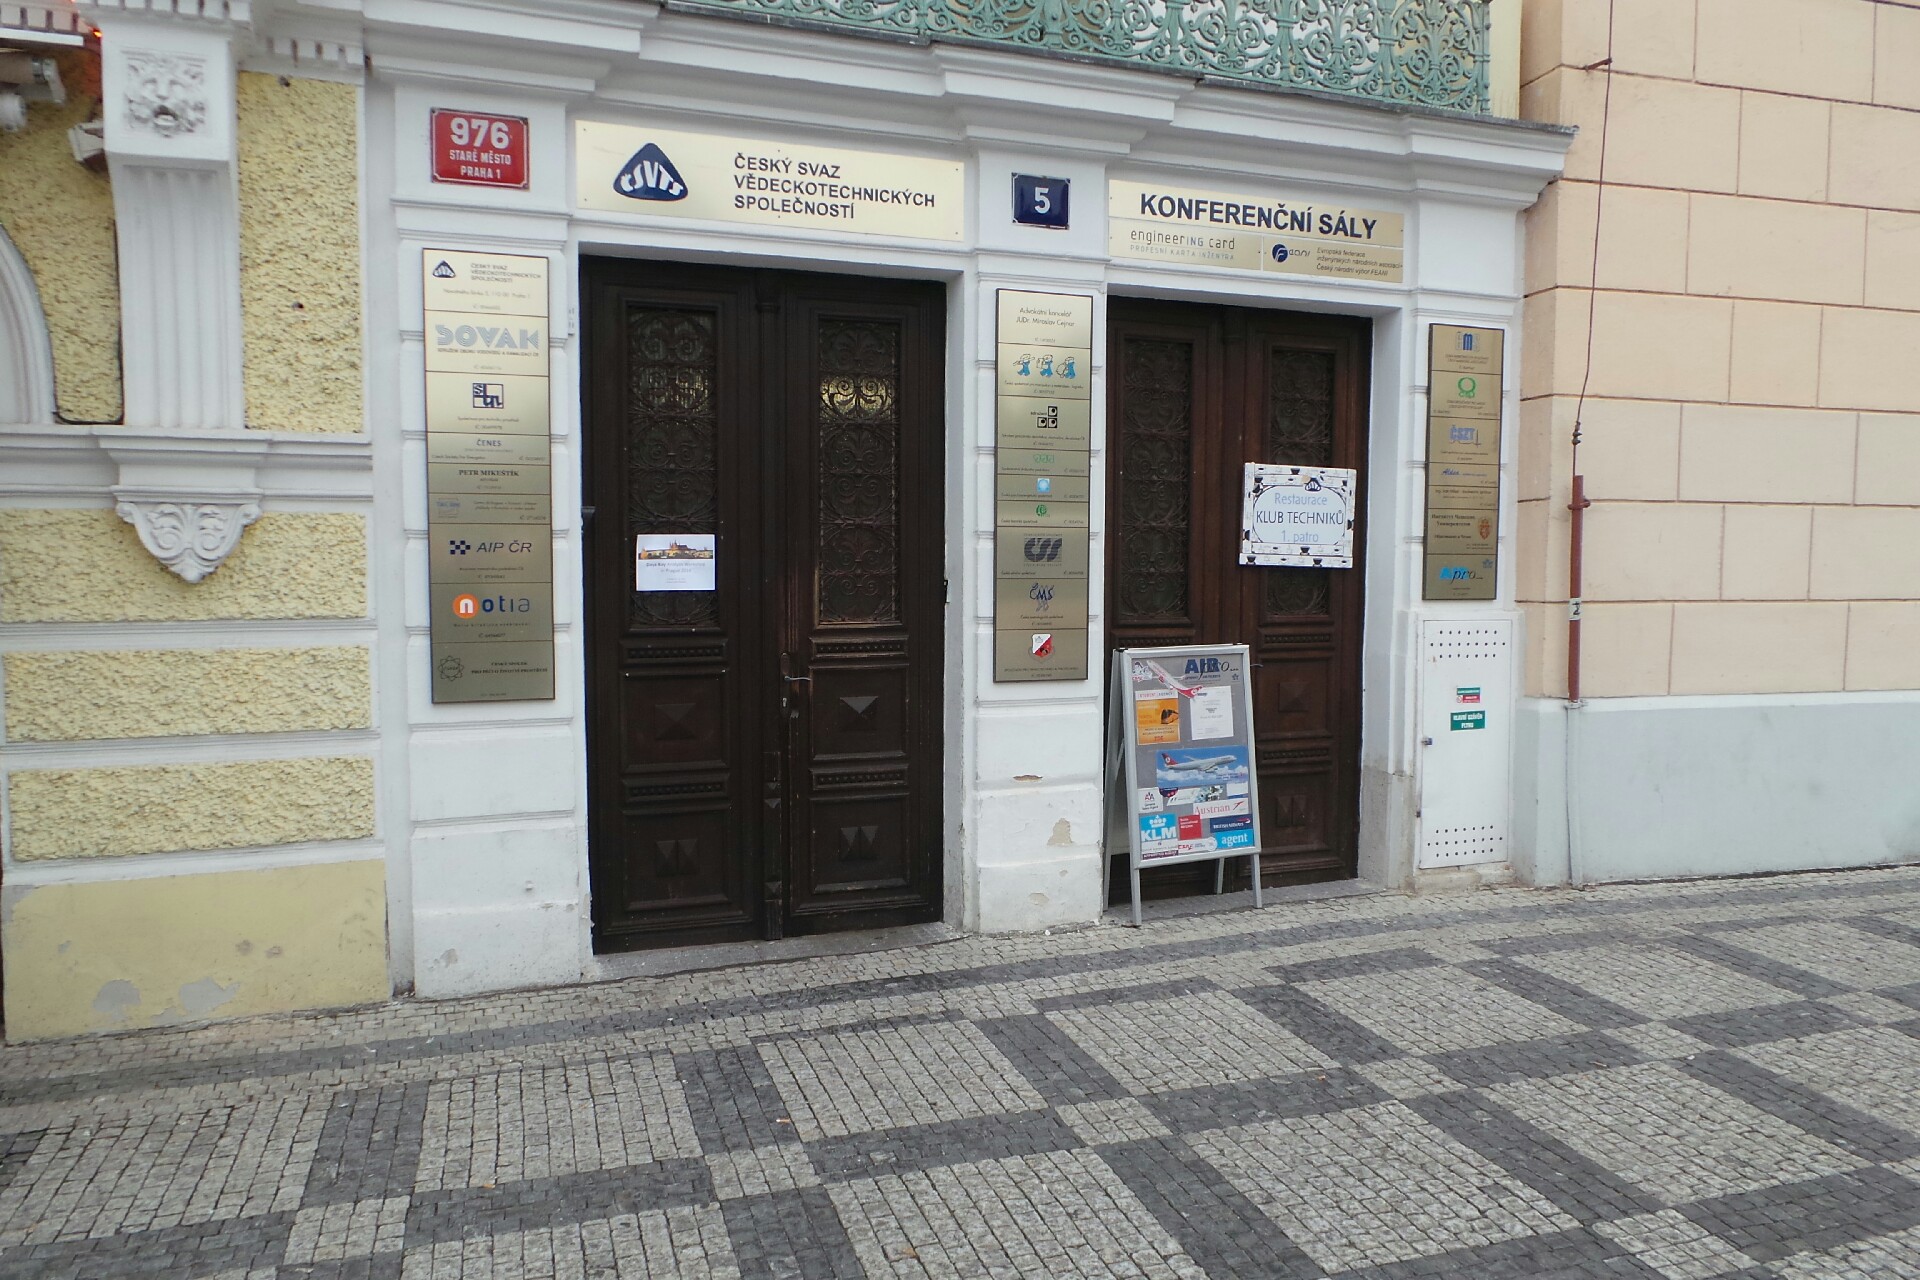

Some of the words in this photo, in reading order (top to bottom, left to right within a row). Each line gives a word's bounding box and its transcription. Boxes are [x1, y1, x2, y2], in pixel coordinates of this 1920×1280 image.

[450, 117, 509, 149] 976
[449, 148, 478, 162] STARÉ
[480, 150, 512, 165] MĚSTO
[460, 165, 493, 179] PRAHA
[495, 168, 501, 179] 1
[734, 152, 791, 174] ČESKÝ
[797, 161, 841, 179] SVAZ
[619, 160, 684, 197] ČSVTS
[734, 173, 936, 208] VĚDECKOTECHNICKÝCH
[734, 194, 855, 219] SPOLEČNOSTÍ
[1034, 187, 1051, 214] 5
[1140, 193, 1312, 233] KONFERENČNÍ
[1318, 209, 1378, 240] SÁLY
[1130, 244, 1167, 254] PROFESNÍ
[1170, 249, 1196, 257] KARTA
[1208, 237, 1235, 250] card
[435, 324, 539, 350] SOVAK
[476, 439, 502, 447] ČENES
[1274, 493, 1328, 506] Restaurace
[1256, 511, 1284, 524] KLUB
[1287, 510, 1344, 525] TECHNIKŮ
[1281, 530, 1290, 542] 1.
[1293, 531, 1319, 544] patro
[476, 542, 504, 553] AIP
[508, 540, 533, 553] ČR
[459, 595, 531, 614] notia
[1194, 804, 1231, 816] Austrian
[1140, 827, 1177, 842] KLM
[1221, 833, 1248, 847] agent
